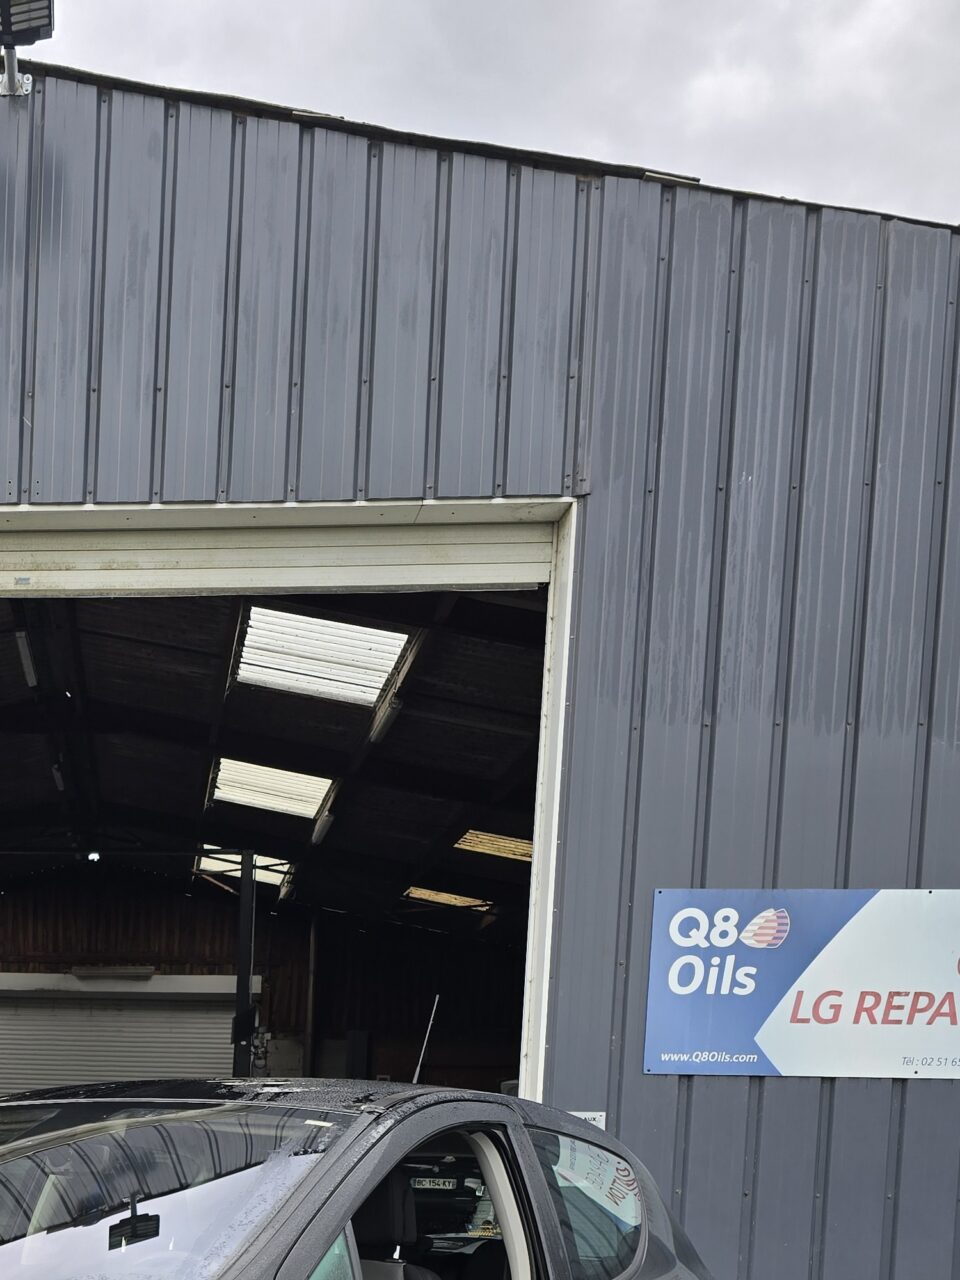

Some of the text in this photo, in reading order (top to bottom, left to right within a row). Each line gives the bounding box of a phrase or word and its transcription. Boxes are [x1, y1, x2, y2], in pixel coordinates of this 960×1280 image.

[669, 907, 739, 948] Q8
[668, 954, 757, 996] Oils
[790, 990, 844, 1025] LG
[661, 1051, 758, 1063] www.Q8Oils.com
[921, 1056, 935, 1067] 02
